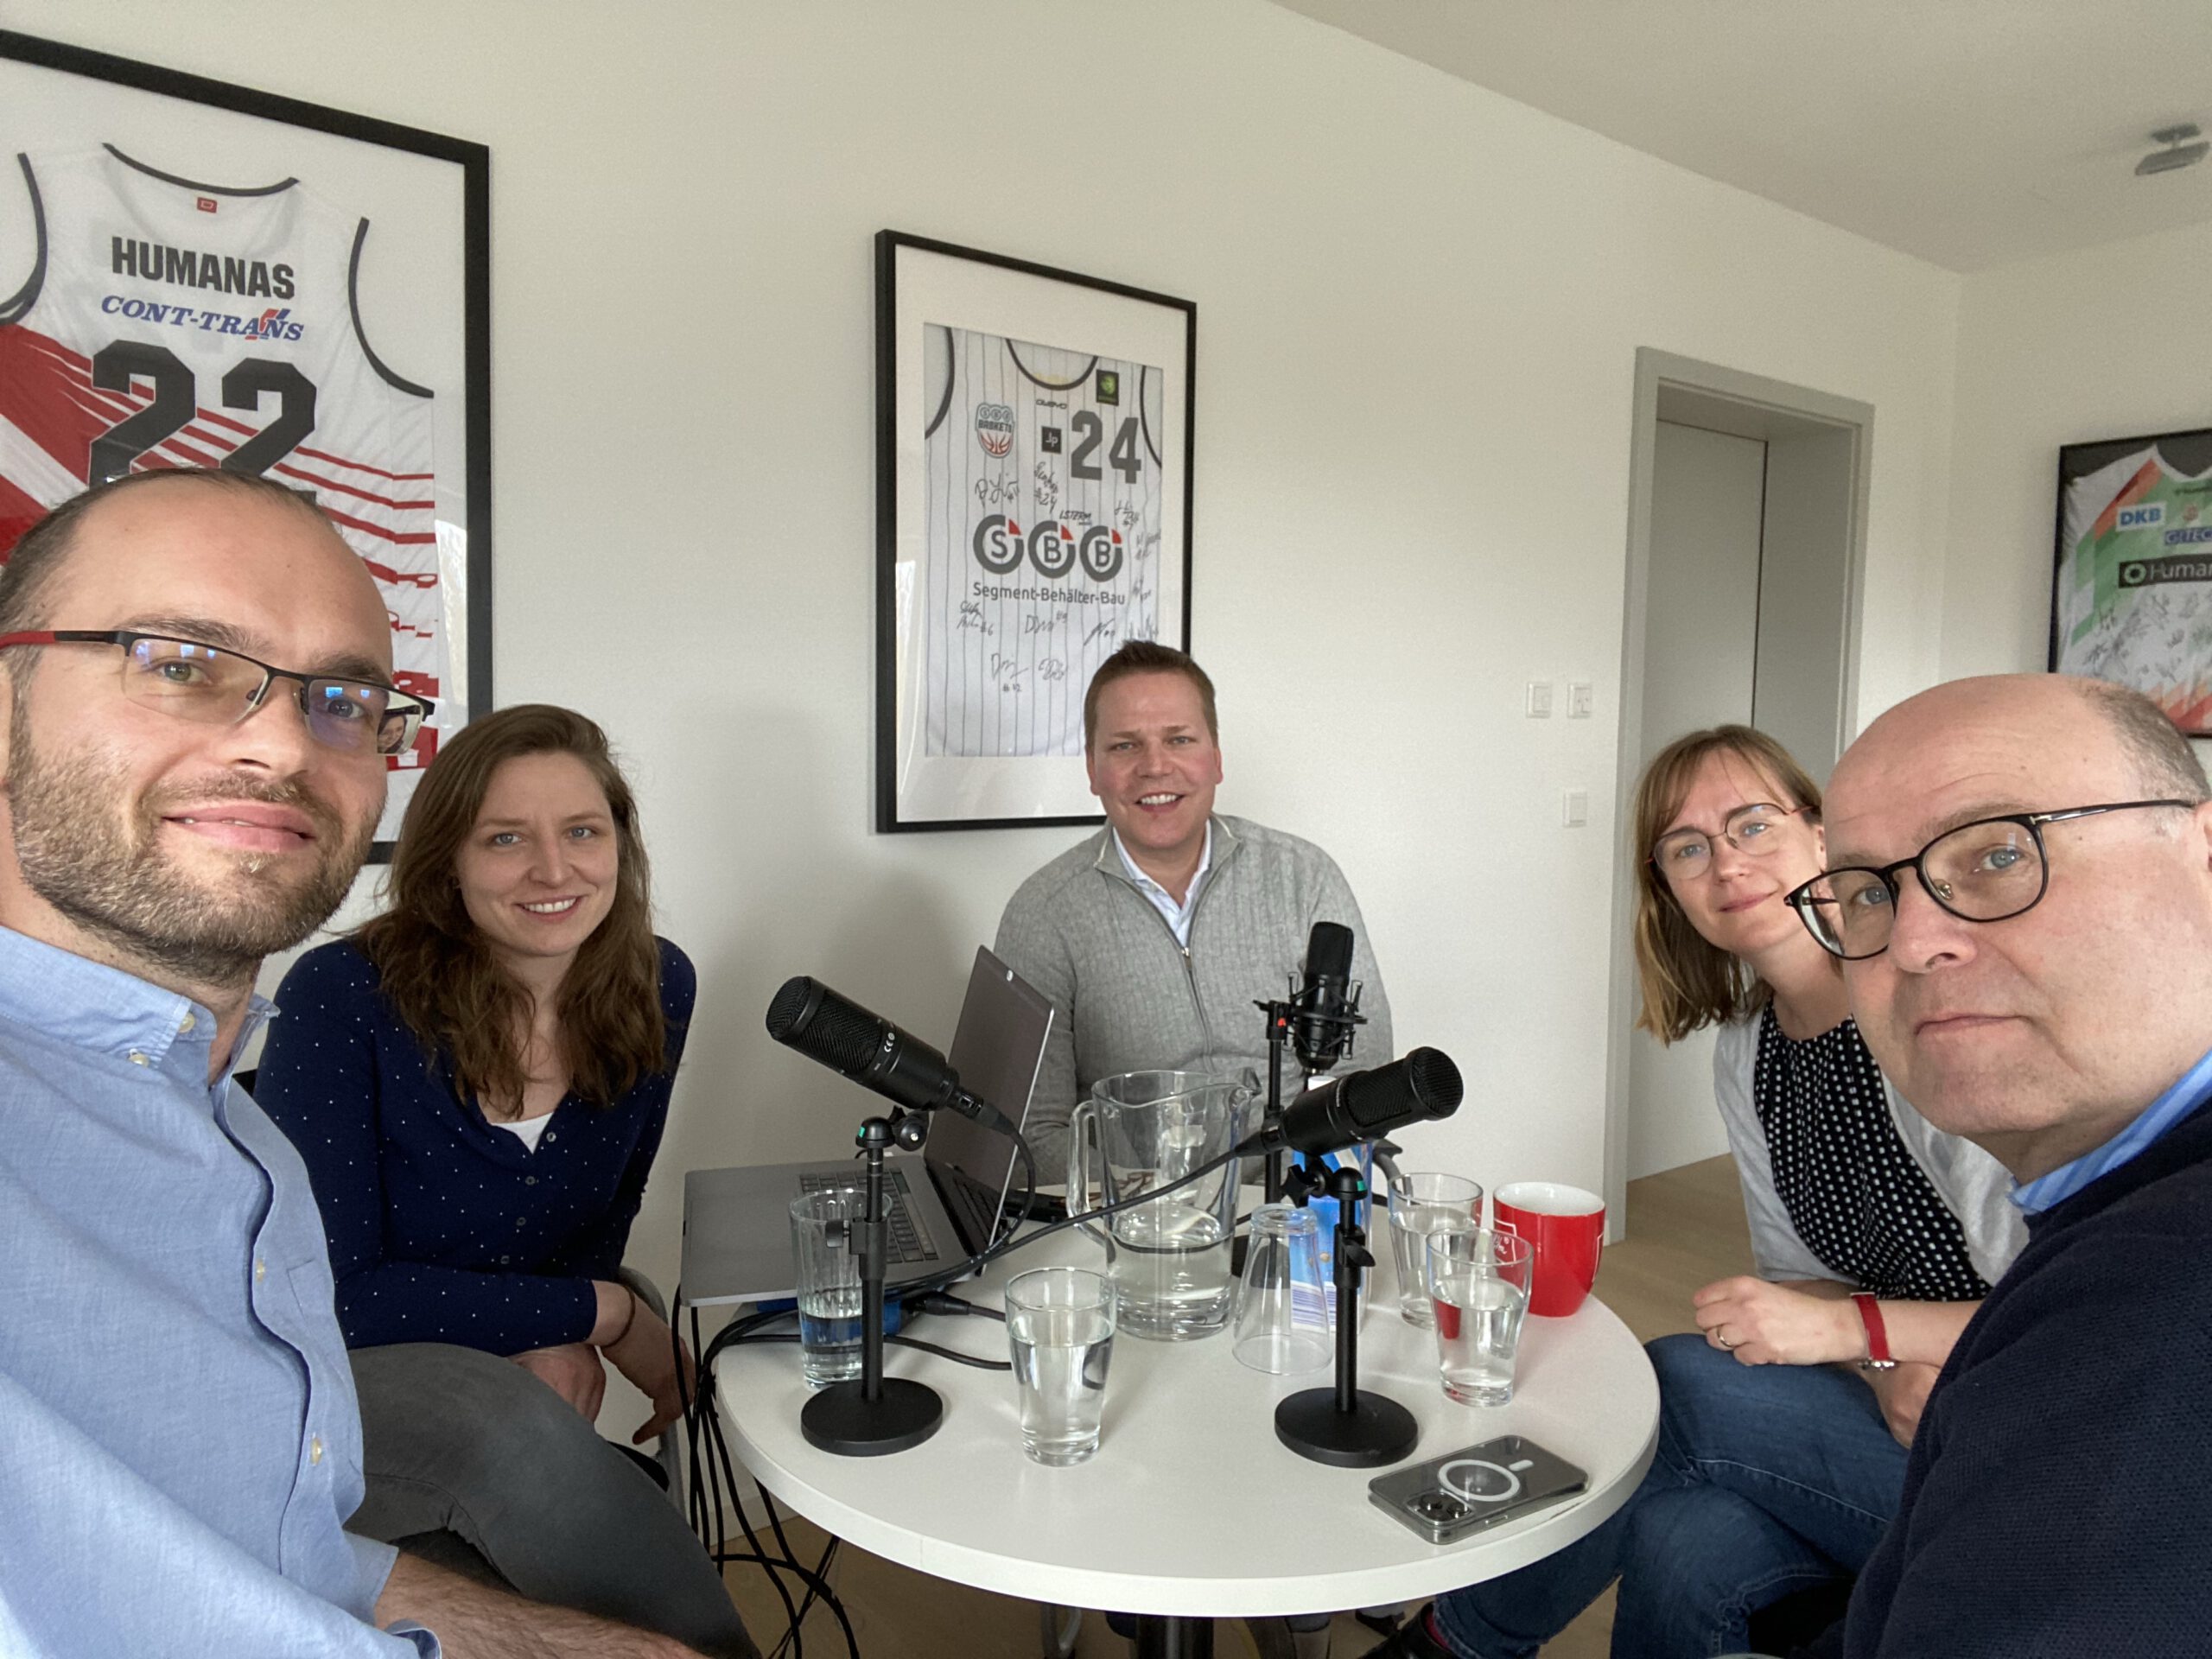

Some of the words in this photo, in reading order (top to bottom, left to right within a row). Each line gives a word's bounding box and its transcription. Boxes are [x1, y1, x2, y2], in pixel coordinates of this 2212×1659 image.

[111, 236, 295, 300] HUMANAS
[101, 295, 304, 341] CONT-TRANS
[1070, 410, 1141, 485] 24
[2120, 508, 2162, 526] DKB
[973, 582, 1125, 606] Segment-Behälter-Bau
